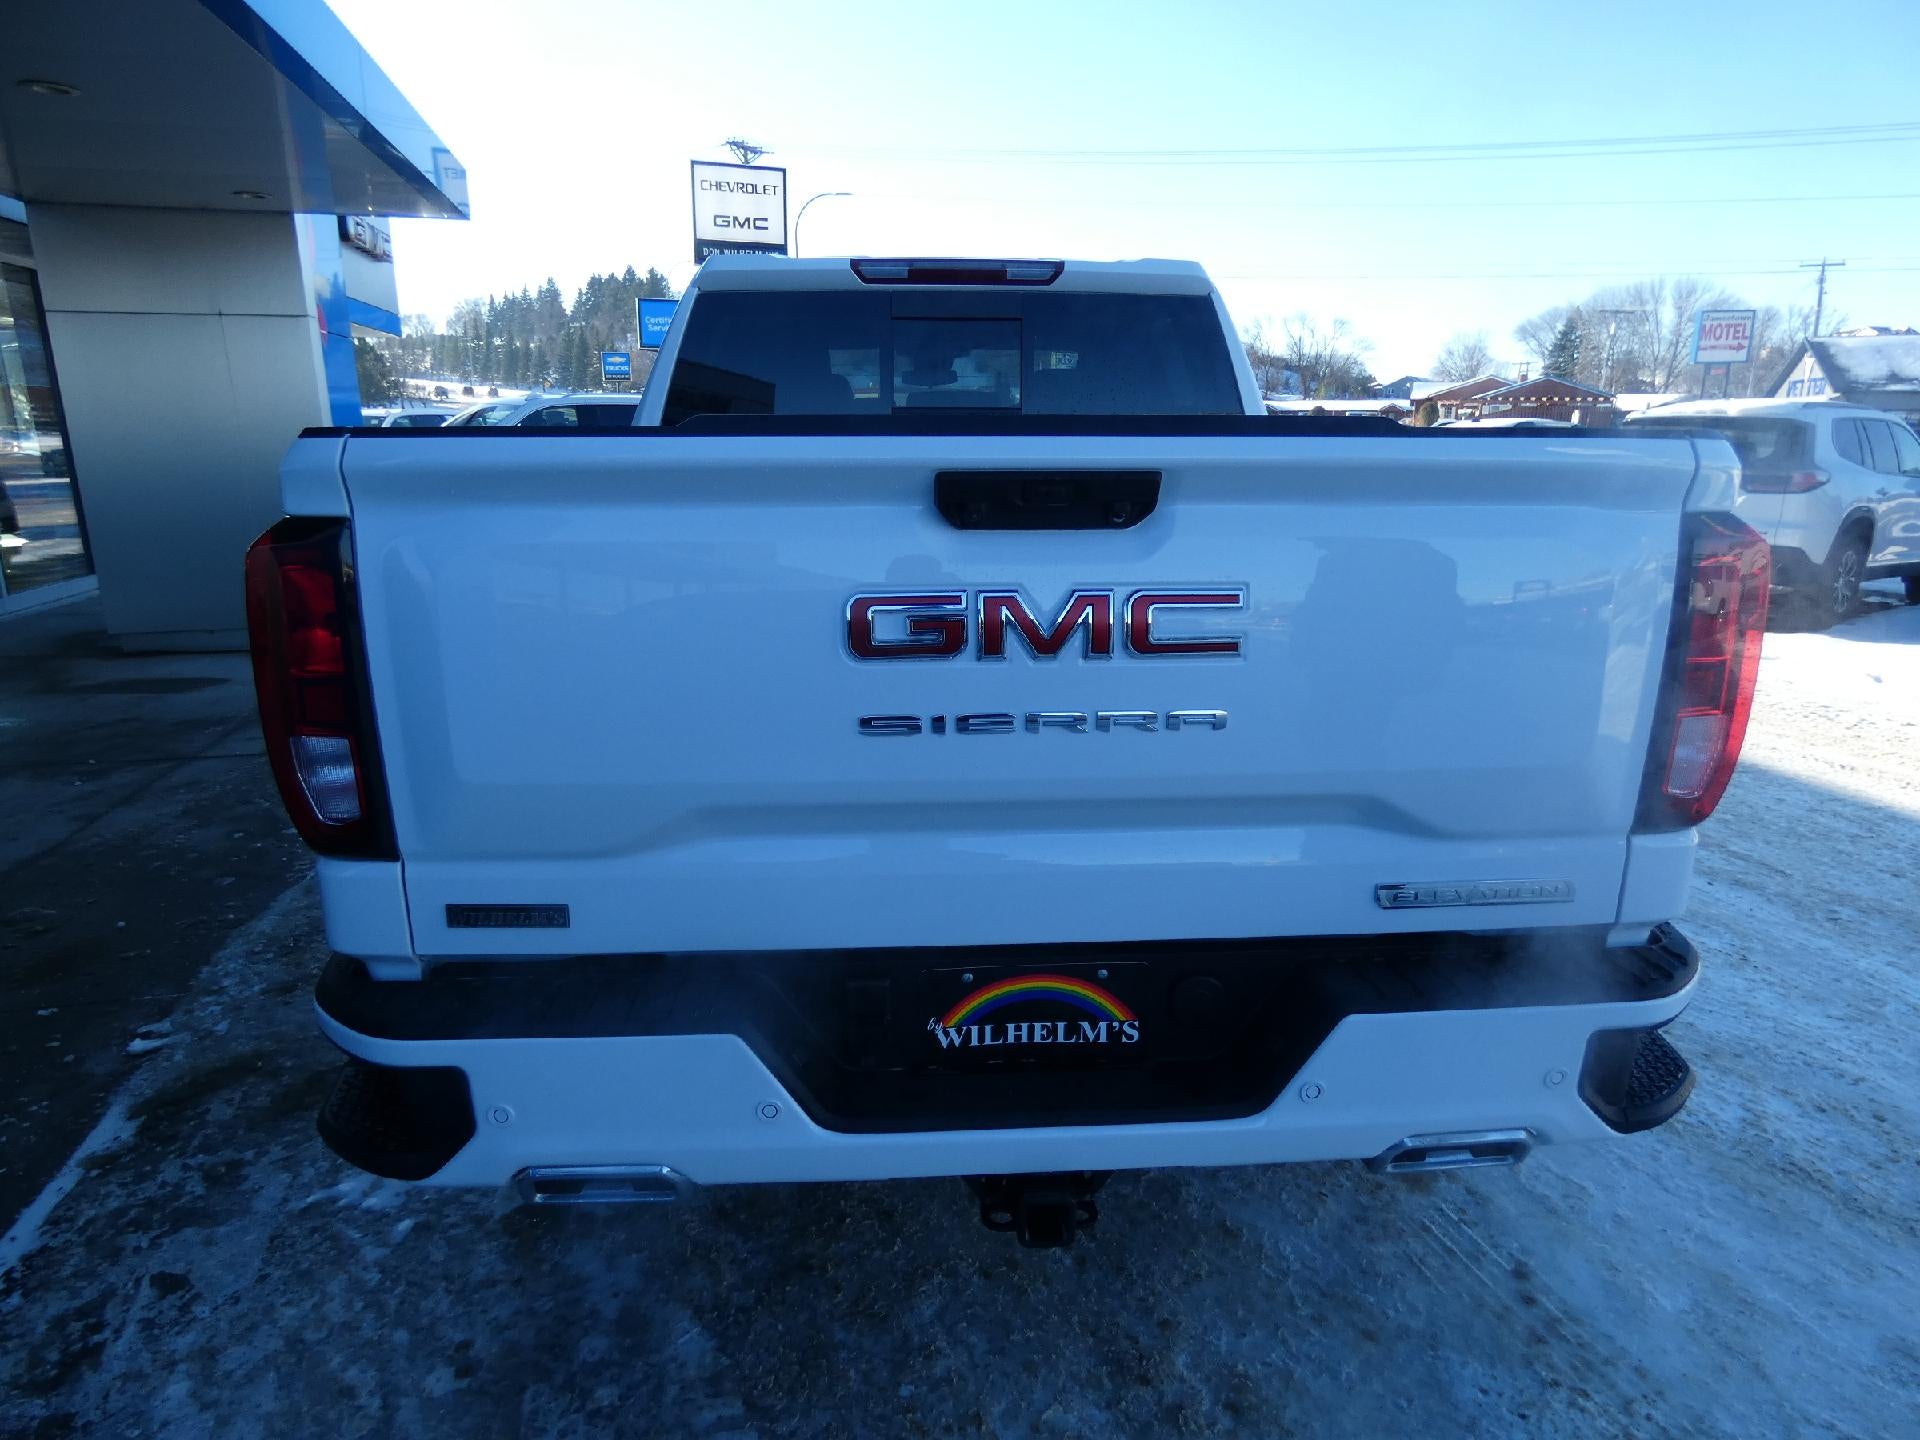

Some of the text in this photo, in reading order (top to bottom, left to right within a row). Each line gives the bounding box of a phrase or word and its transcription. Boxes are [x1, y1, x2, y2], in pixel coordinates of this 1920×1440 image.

[700, 179, 779, 196] CHEVROLET
[713, 214, 769, 231] GMC
[1701, 322, 1749, 341] MOTEL
[846, 588, 1246, 662] GMC
[858, 709, 1228, 736] SIERRA
[927, 1017, 1139, 1049] by WILHELM'S
